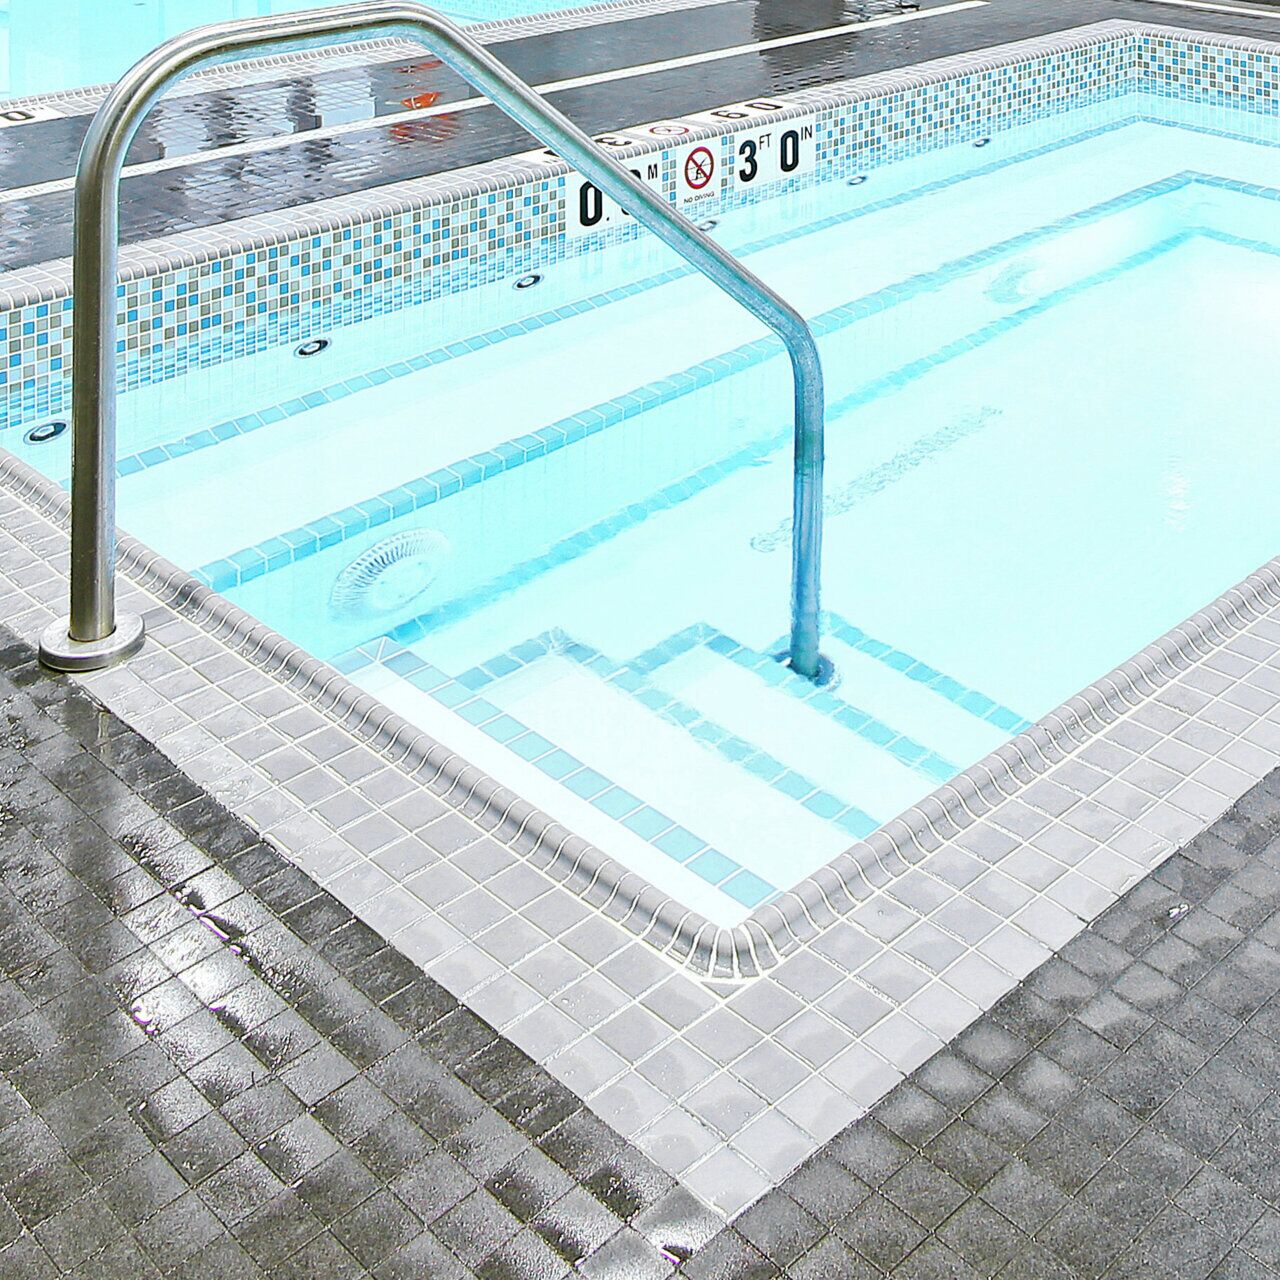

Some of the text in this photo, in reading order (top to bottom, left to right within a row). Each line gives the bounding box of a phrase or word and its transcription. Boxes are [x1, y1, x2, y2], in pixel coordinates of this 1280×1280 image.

[647, 163, 658, 181] M
[739, 140, 758, 183] 3
[759, 133, 772, 150] FT
[780, 130, 799, 172] 0
[801, 125, 813, 141] IN
[684, 191, 715, 204] NO DIVING
